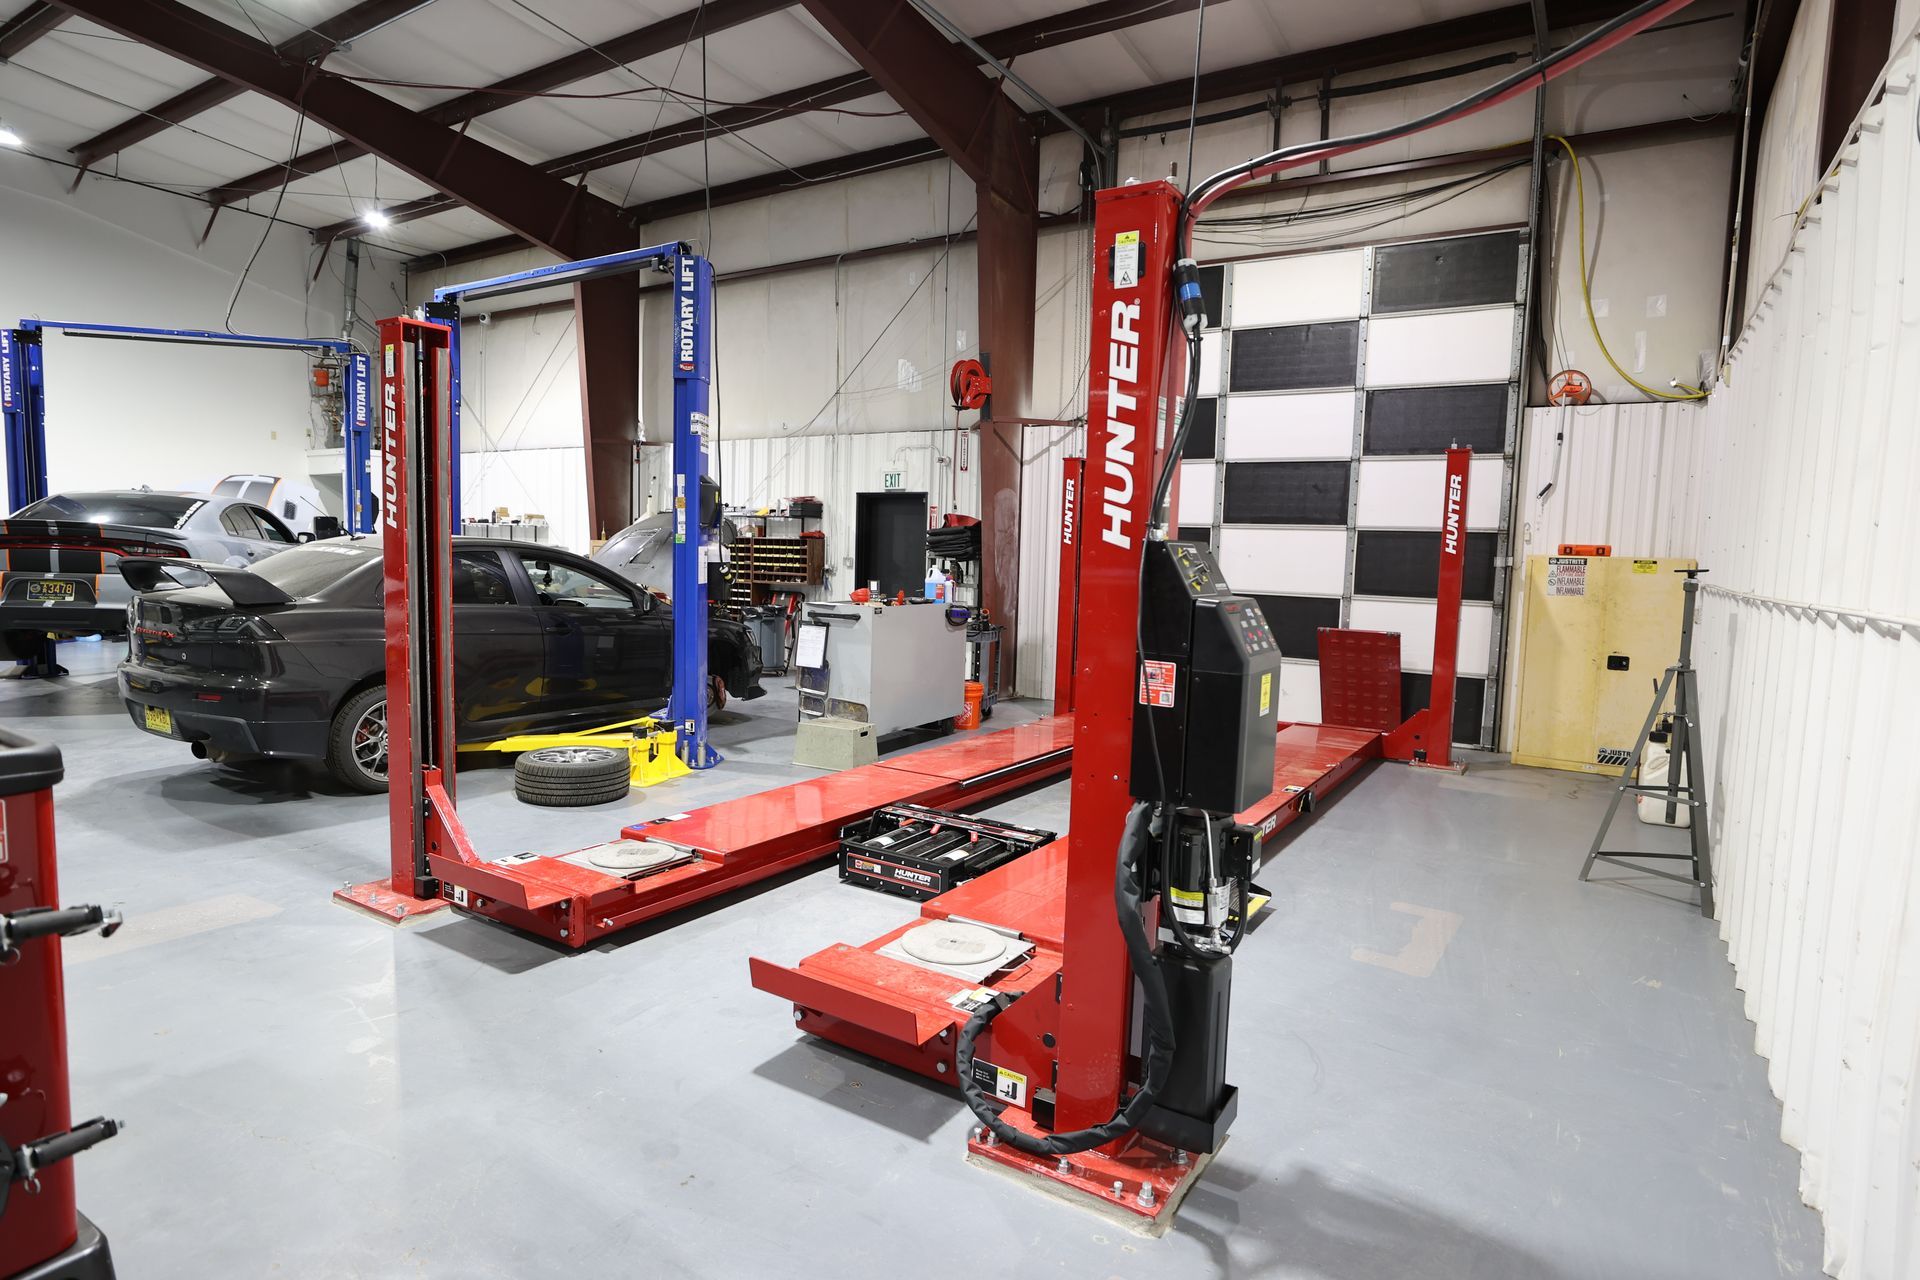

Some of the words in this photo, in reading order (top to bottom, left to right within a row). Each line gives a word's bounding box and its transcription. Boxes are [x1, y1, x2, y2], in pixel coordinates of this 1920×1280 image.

[681, 257, 694, 291] LIFT
[681, 296, 694, 361] ROTARY
[1, 330, 9, 353] LIFT
[356, 354, 366, 378] LIFT
[2, 356, 12, 401] ROTARY
[356, 378, 366, 421] ROTARY
[1102, 300, 1140, 550] HUNTER
[385, 383, 397, 528] HUNTER
[884, 473, 901, 488] EXIT
[1063, 478, 1075, 545] HUNTER
[1445, 474, 1462, 555] HUNTER
[1557, 565, 1585, 573] FLAMMABLE
[1556, 587, 1584, 596] INFLAMMABLE
[1557, 577, 1584, 586] INFLAMABLE
[1607, 749, 1631, 757] JUSTR
[1261, 814, 1277, 837] TER
[894, 868, 931, 882] HUNTER
[1003, 1071, 1024, 1082] CAUTION
